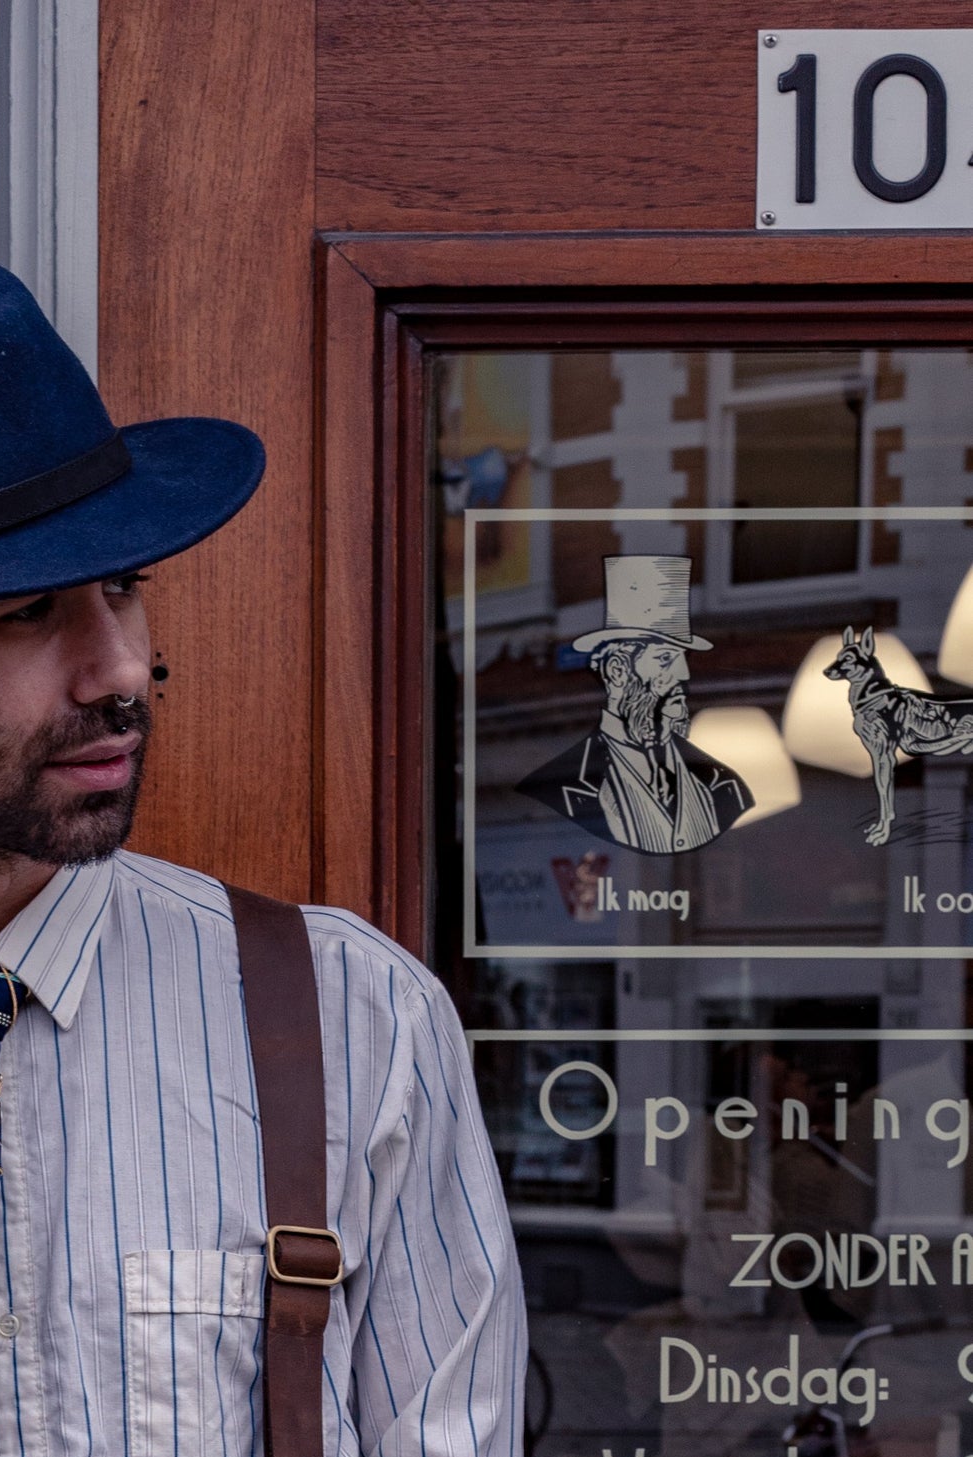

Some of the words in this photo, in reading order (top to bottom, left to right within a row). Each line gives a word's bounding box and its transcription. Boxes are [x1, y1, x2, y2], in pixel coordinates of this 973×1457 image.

[777, 53, 973, 204] 10
[627, 889, 690, 921] mag
[539, 1060, 970, 1170] Opening
[729, 1231, 937, 1290] ZONDER
[660, 1334, 889, 1427] Dinsdag:
